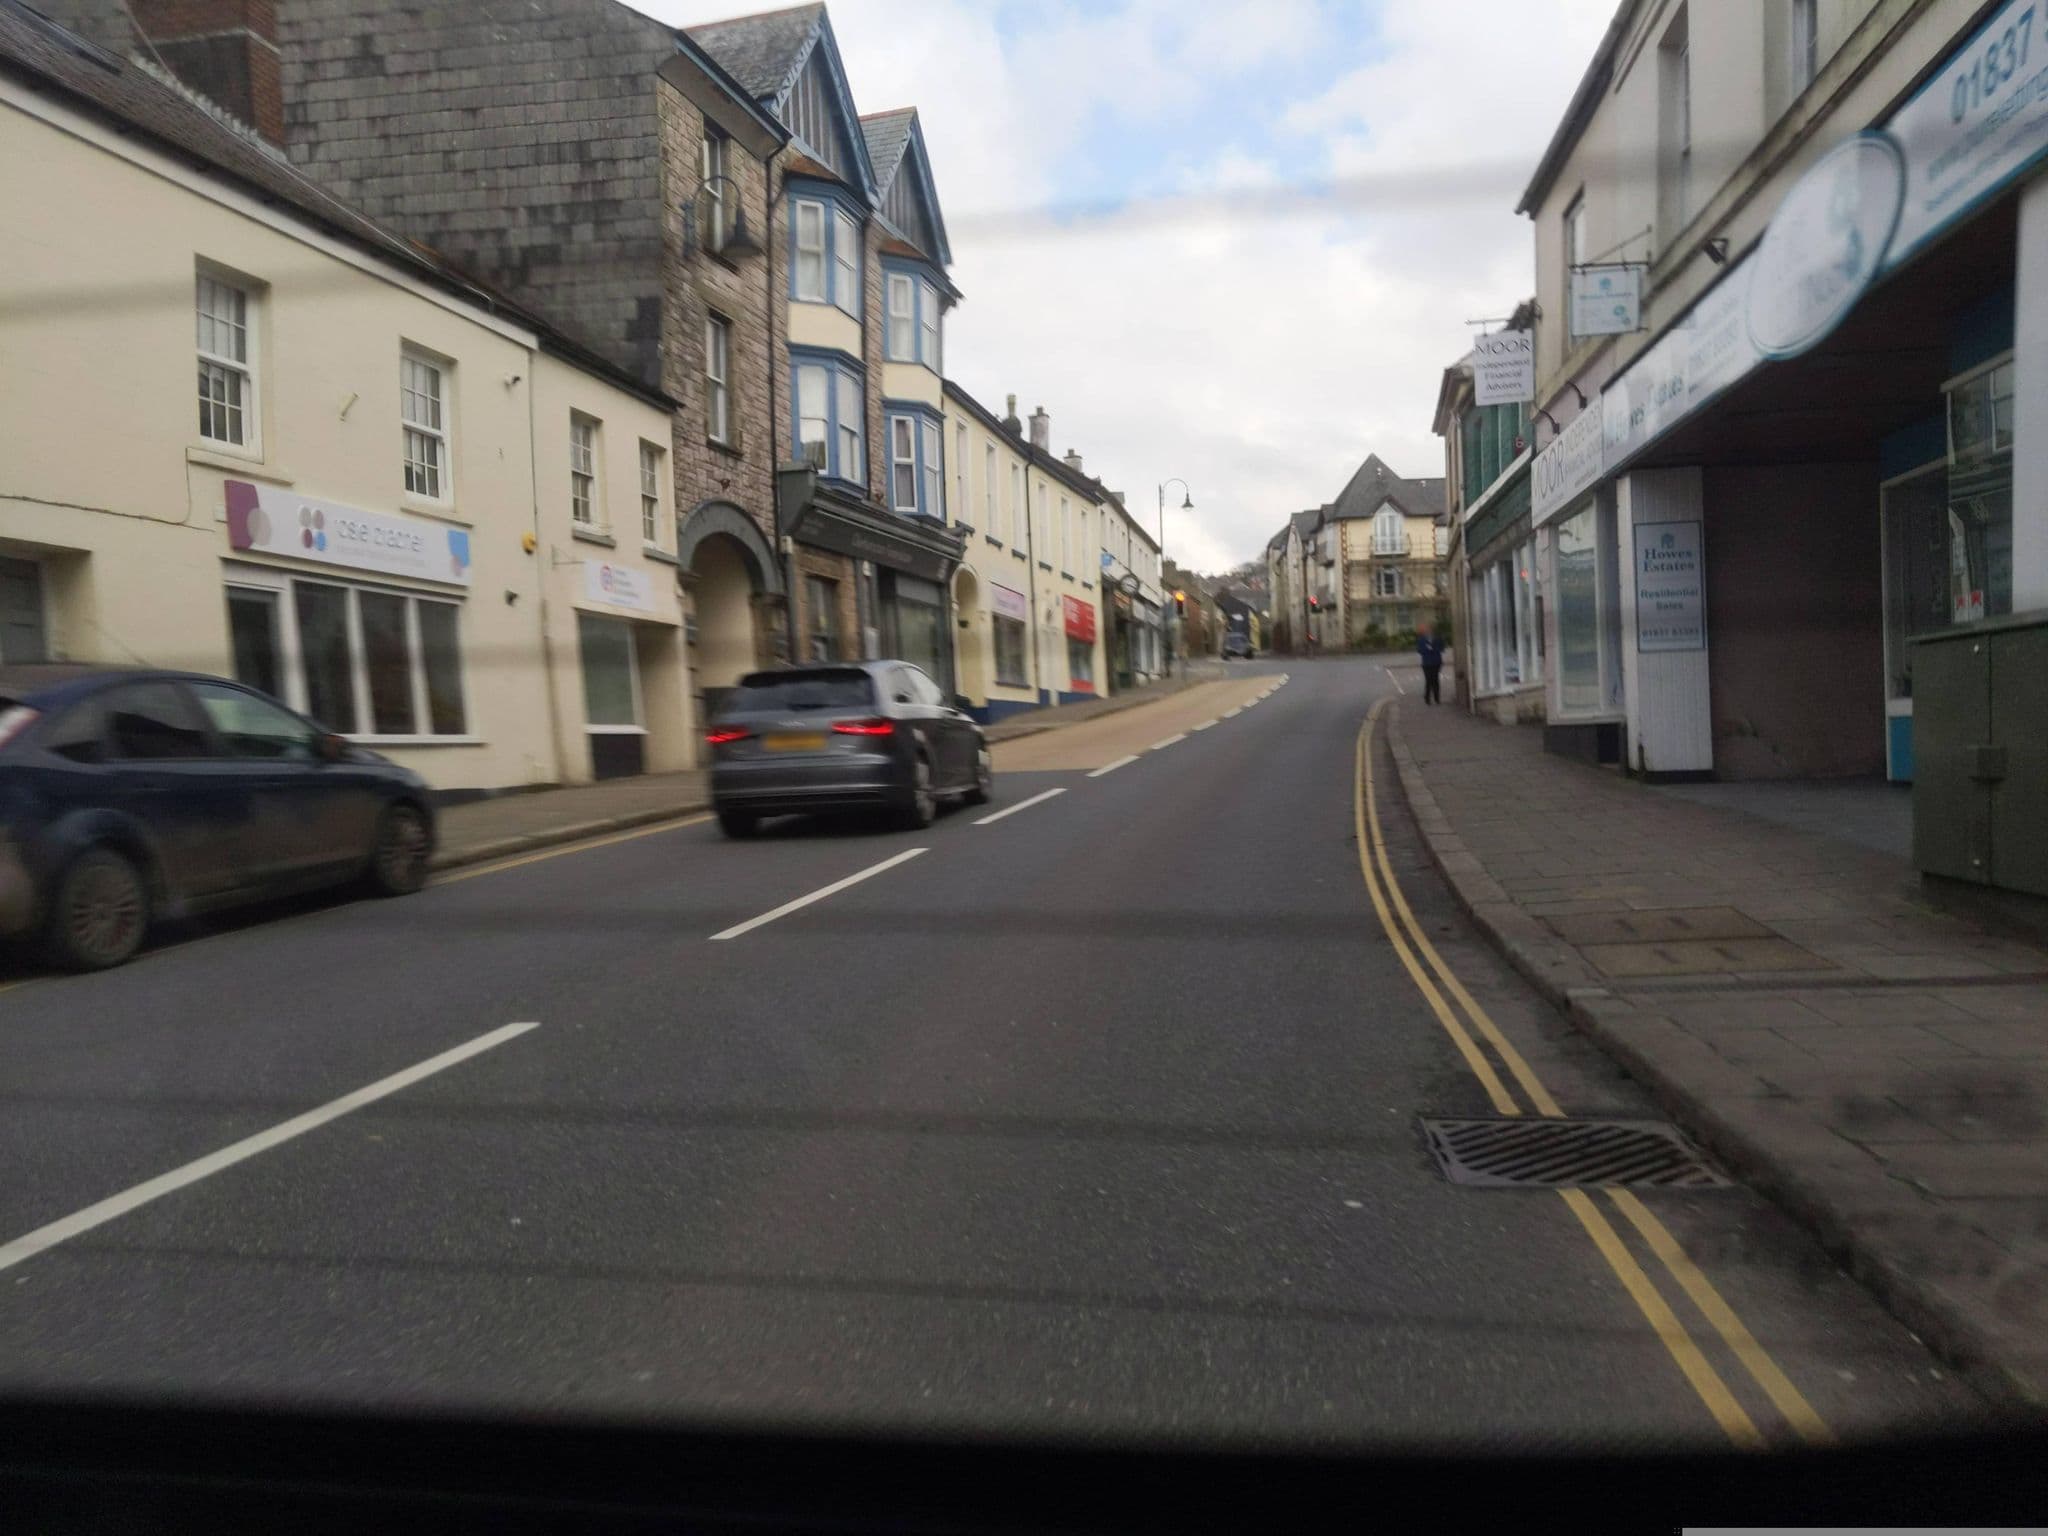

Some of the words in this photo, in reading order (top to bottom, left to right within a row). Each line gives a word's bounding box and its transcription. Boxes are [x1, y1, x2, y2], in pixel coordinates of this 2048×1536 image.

[1950, 6, 2035, 124] 01837
[1474, 339, 1531, 354] MOOR
[1644, 548, 1693, 560] Howes
[1643, 560, 1695, 573] Estates
